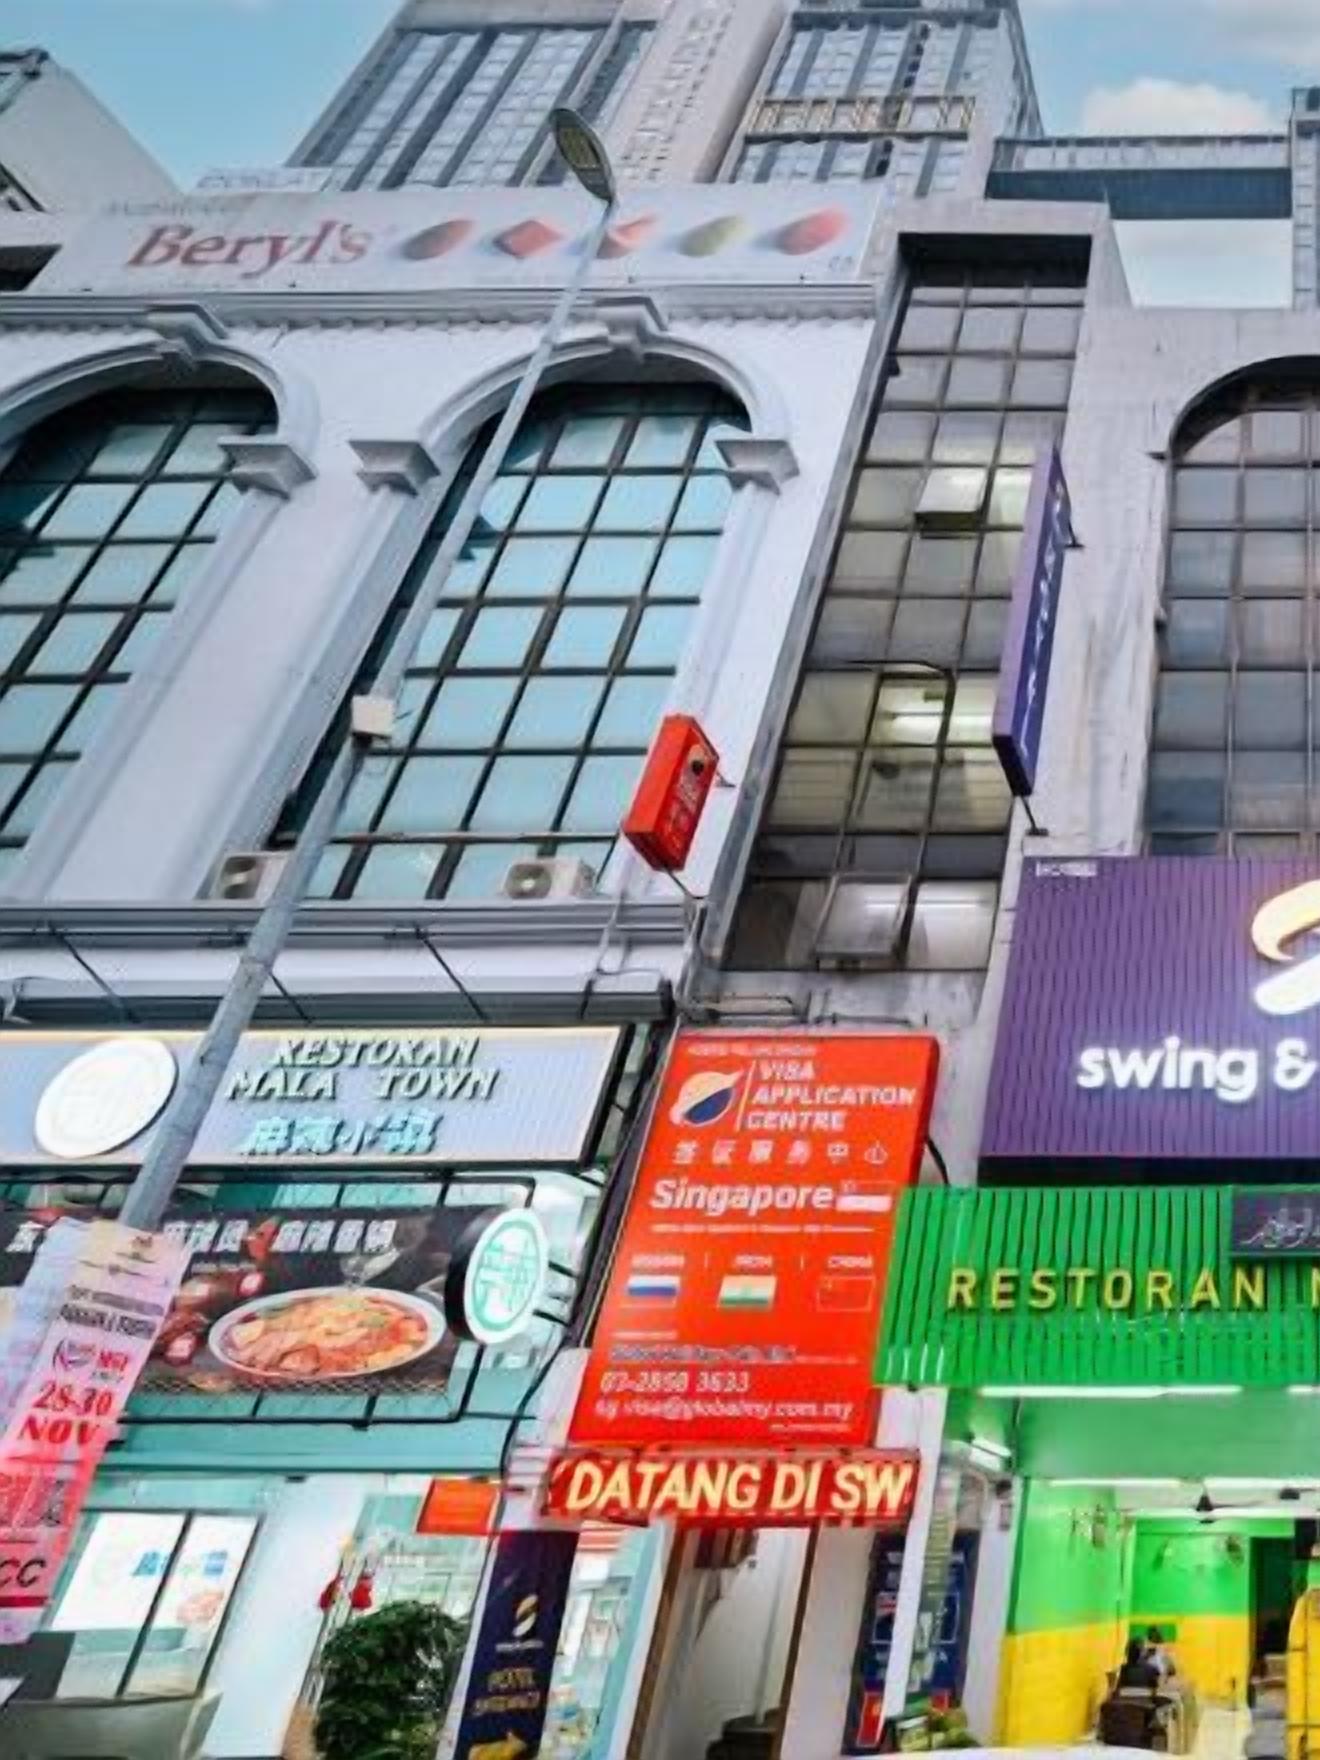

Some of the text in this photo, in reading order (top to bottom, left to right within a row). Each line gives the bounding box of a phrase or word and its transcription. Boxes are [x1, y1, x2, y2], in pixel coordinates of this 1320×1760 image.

[128, 220, 372, 279] Beryl's
[227, 1068, 499, 1101] MALA TOWN
[760, 1061, 815, 1080] VISA
[1077, 1036, 1258, 1103] swing
[1274, 1038, 1318, 1090] &
[753, 1086, 916, 1105] APPLICATION
[748, 1112, 847, 1130] CENTRE
[652, 1177, 833, 1216] Singapore
[947, 1267, 1266, 1310] RESTORAN
[20, 1416, 98, 1446] NOV
[564, 1460, 763, 1510] DATANG
[770, 1461, 822, 1510] DI
